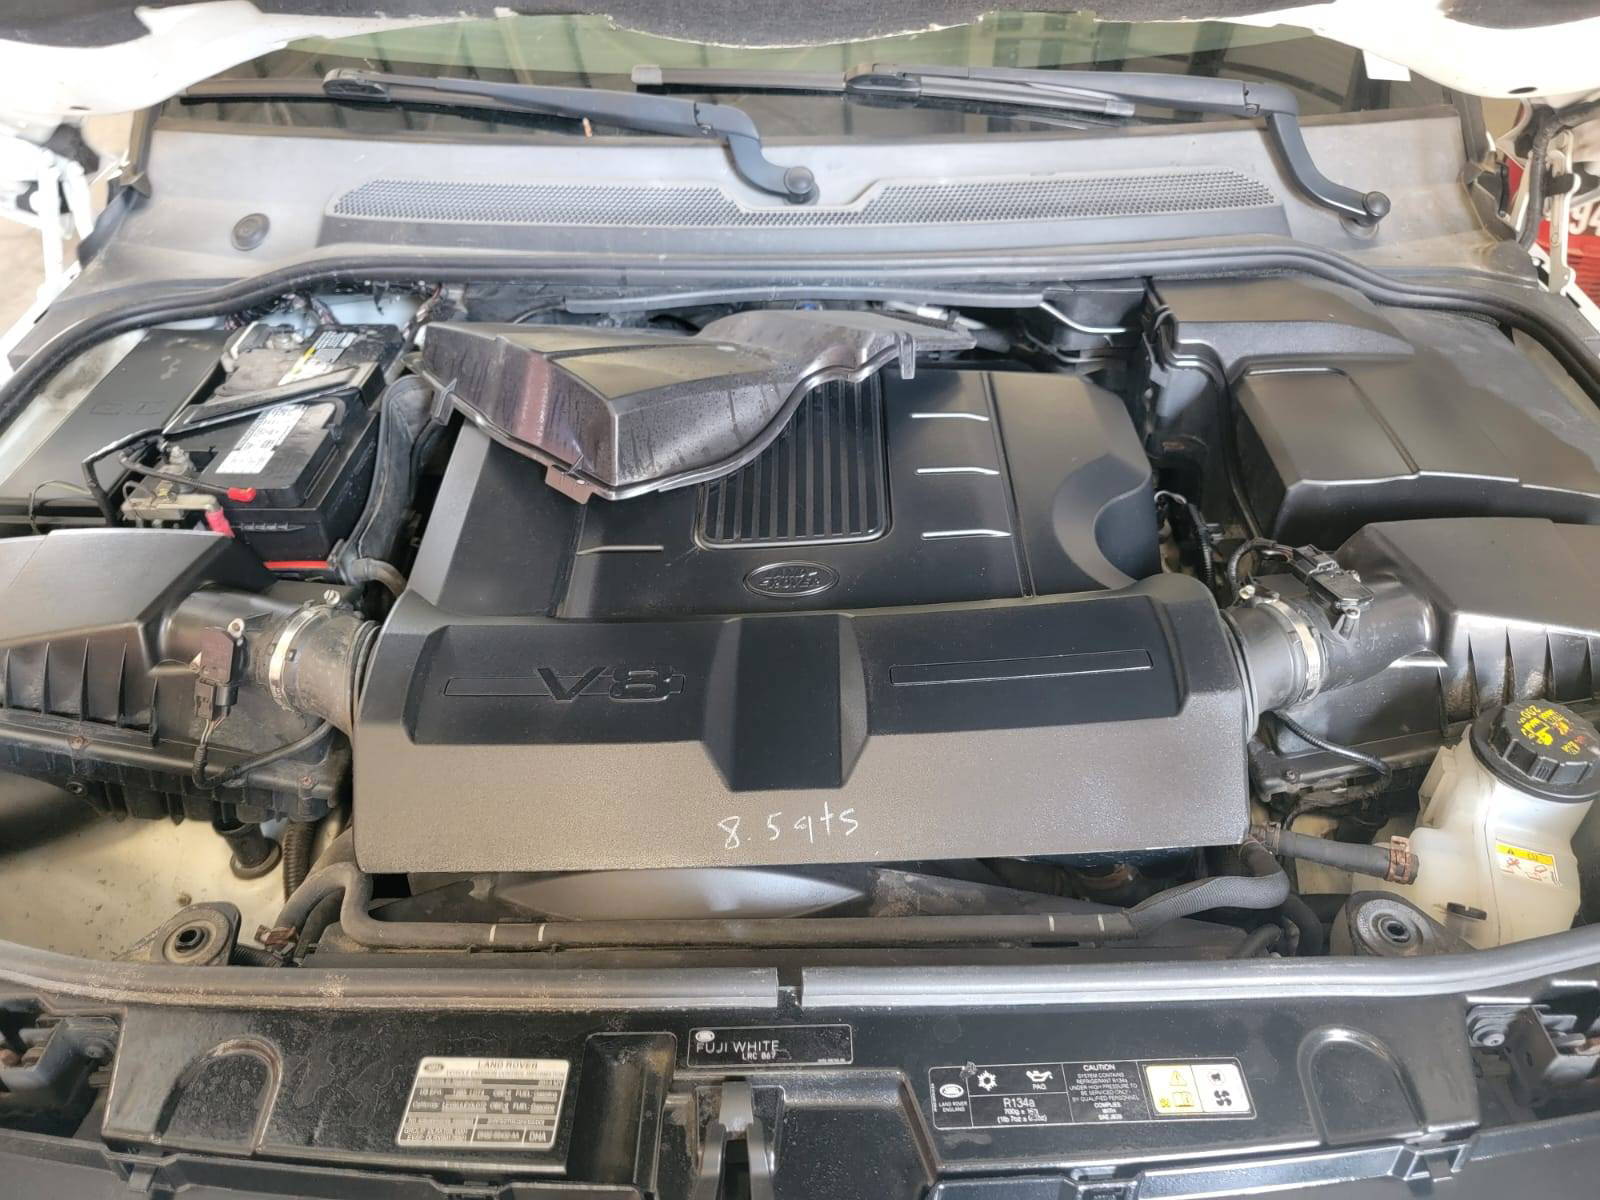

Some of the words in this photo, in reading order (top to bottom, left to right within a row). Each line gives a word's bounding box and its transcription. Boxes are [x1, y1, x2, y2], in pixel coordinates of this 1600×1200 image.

[535, 665, 674, 703] V8
[793, 801, 859, 843] qts
[696, 1041, 728, 1054] FUJI
[732, 1039, 780, 1053] WHITE
[741, 1050, 757, 1060] LRC
[477, 1061, 502, 1069] LAND
[1003, 1097, 1036, 1108] R134a
